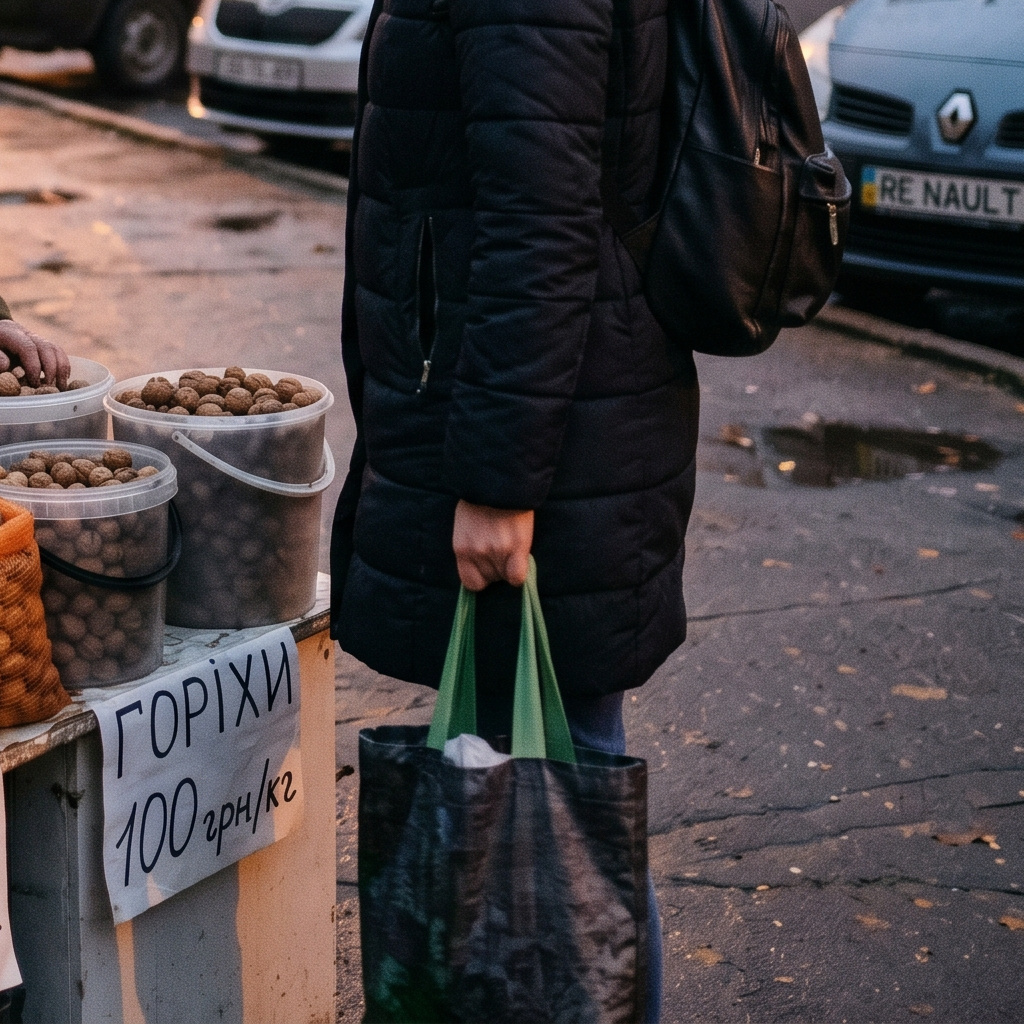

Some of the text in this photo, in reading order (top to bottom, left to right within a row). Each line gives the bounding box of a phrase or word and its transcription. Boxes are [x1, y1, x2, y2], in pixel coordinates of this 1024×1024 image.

[879, 176, 1020, 215] RE NAULT
[115, 641, 292, 779] ГОРІХИ
